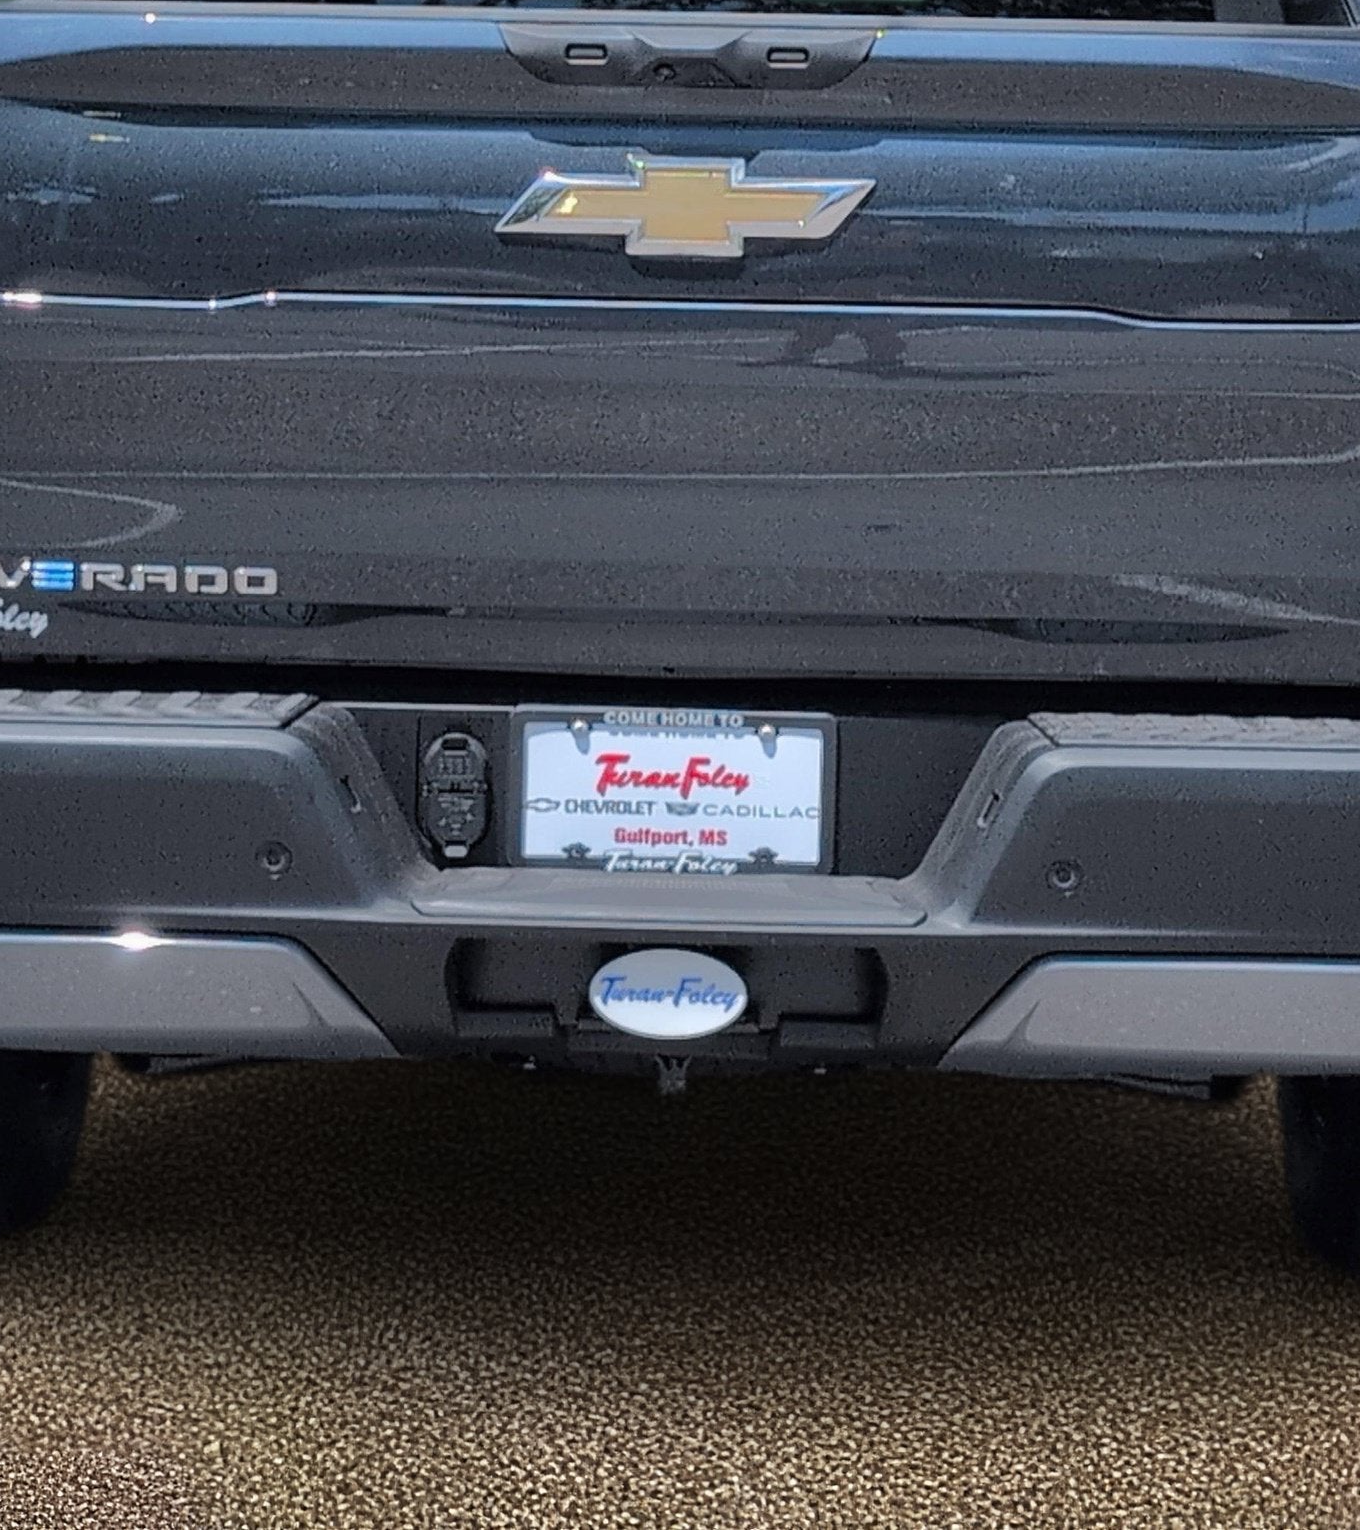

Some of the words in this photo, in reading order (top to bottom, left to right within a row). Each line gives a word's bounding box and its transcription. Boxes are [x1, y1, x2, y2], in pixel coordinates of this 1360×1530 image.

[603, 710, 658, 726] COME
[660, 712, 715, 727] HOME
[719, 714, 745, 728] TO
[564, 799, 654, 817] CHEVROLET
[702, 803, 820, 821] CADILLAC
[613, 826, 694, 848] Gulfport,
[698, 828, 728, 847] MS
